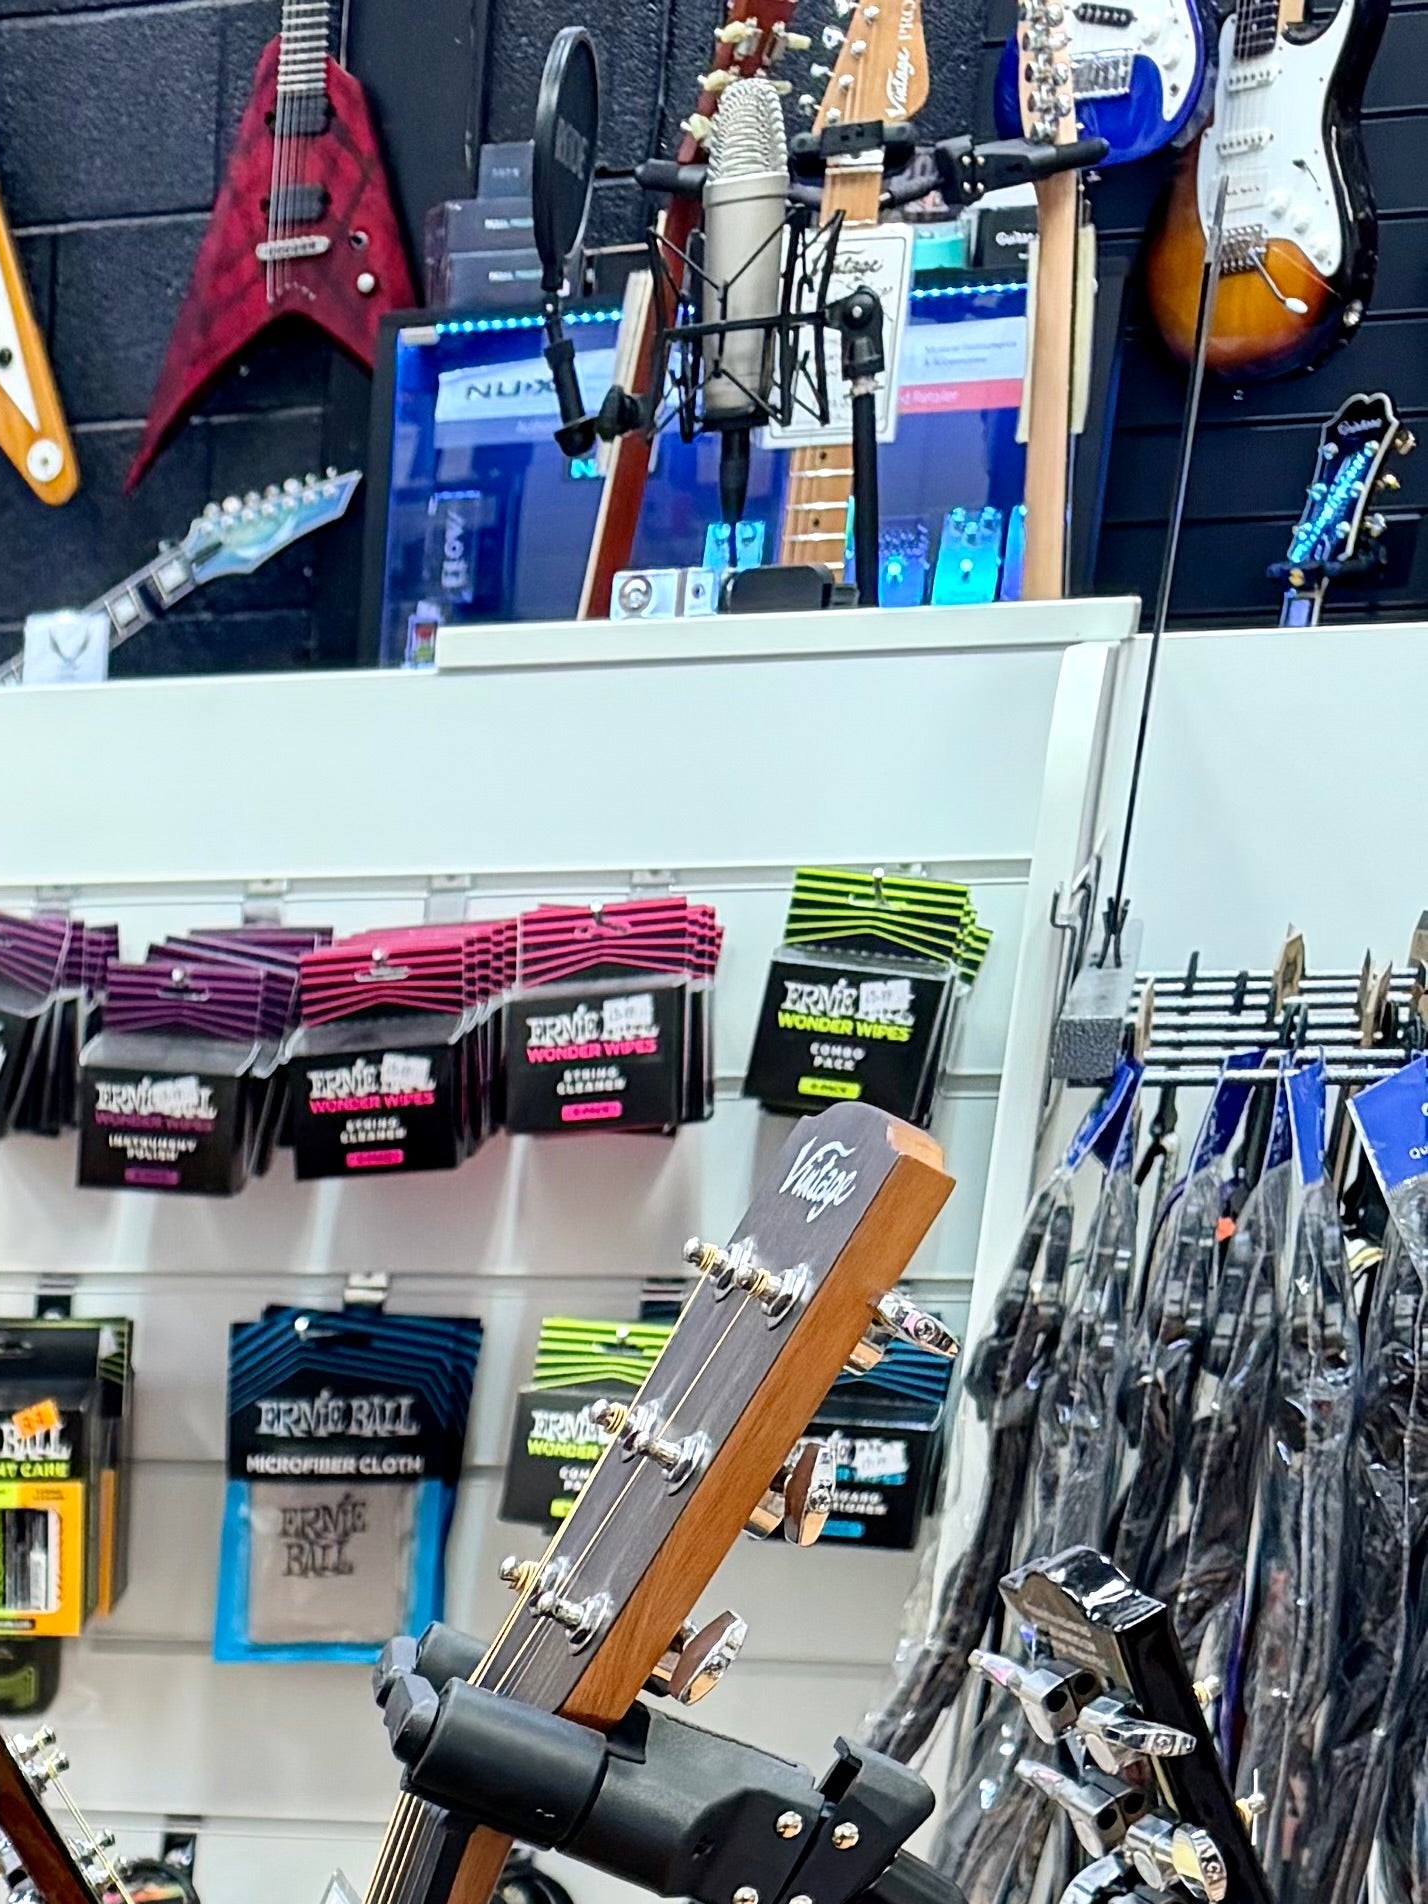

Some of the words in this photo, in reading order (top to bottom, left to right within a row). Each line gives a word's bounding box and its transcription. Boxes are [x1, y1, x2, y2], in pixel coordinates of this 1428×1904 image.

[778, 1010, 853, 1035] WONDER
[526, 1043, 602, 1064] WONDER
[779, 1137, 856, 1223] Vintage
[255, 1386, 345, 1438] ERNIE
[347, 1396, 422, 1438] BALL
[20, 1461, 72, 1478] CARE
[246, 1454, 358, 1476] MICROFIBER
[358, 1454, 425, 1475] CLOTH
[280, 1493, 367, 1545] ERNIE
[283, 1541, 354, 1578] BALL
